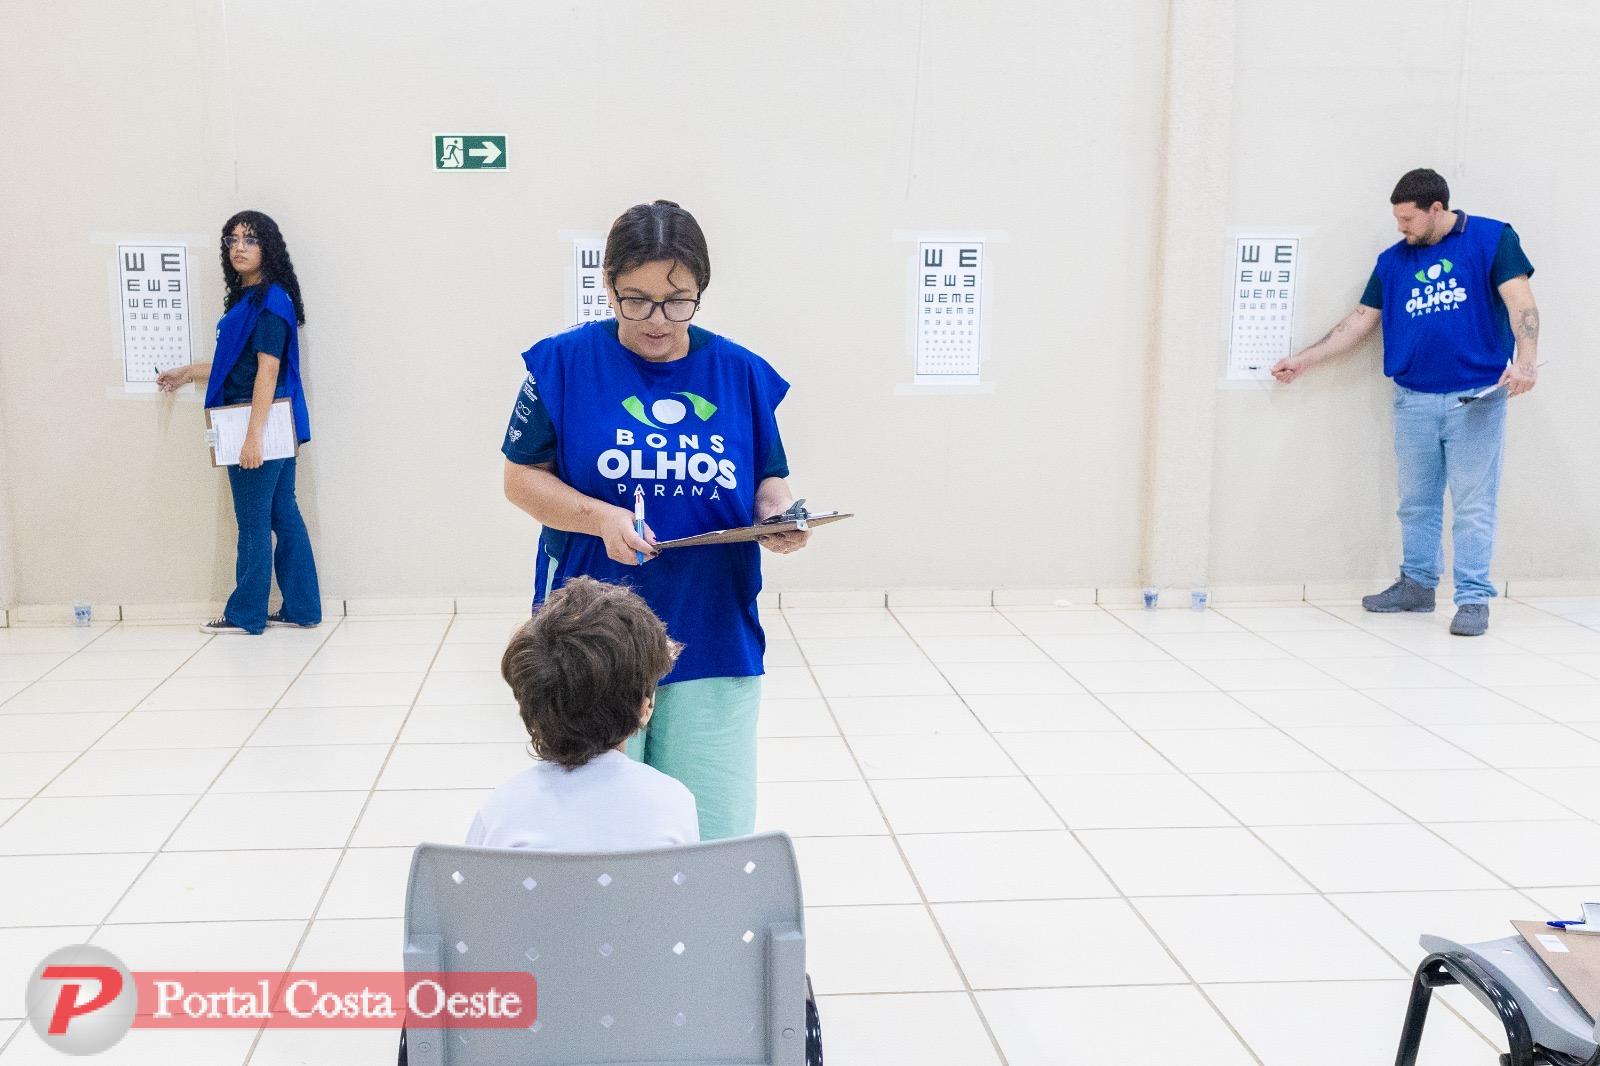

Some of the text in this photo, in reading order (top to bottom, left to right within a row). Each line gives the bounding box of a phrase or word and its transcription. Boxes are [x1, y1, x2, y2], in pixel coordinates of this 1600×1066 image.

[1406, 288, 1467, 313] OLHOS
[1412, 278, 1457, 298] BONS
[616, 428, 724, 454] BONS
[597, 448, 737, 490] OLHOS
[618, 484, 720, 500] PARANÁ
